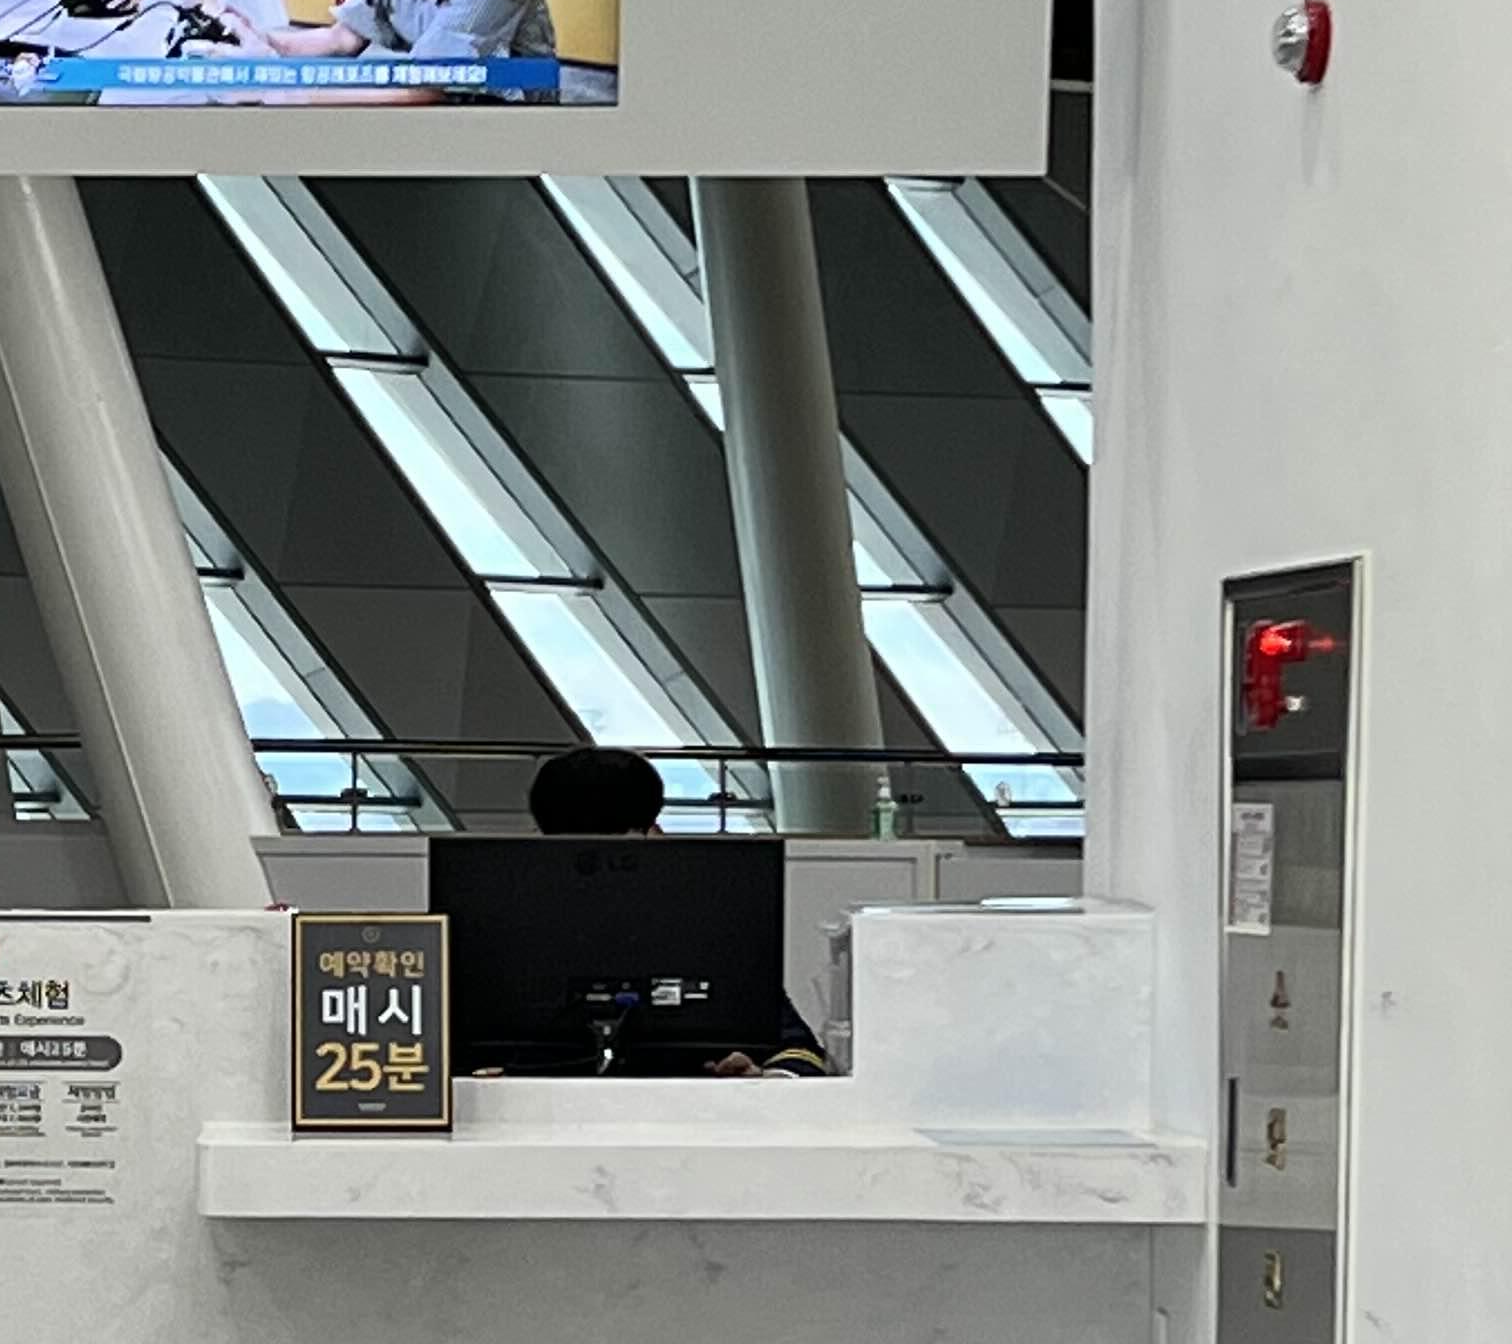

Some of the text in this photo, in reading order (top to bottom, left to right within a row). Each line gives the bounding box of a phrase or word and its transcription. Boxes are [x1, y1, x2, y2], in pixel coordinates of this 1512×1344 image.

[319, 950, 425, 979] 예약확인
[321, 984, 422, 1036] 매시
[315, 1042, 430, 1092] 25분
